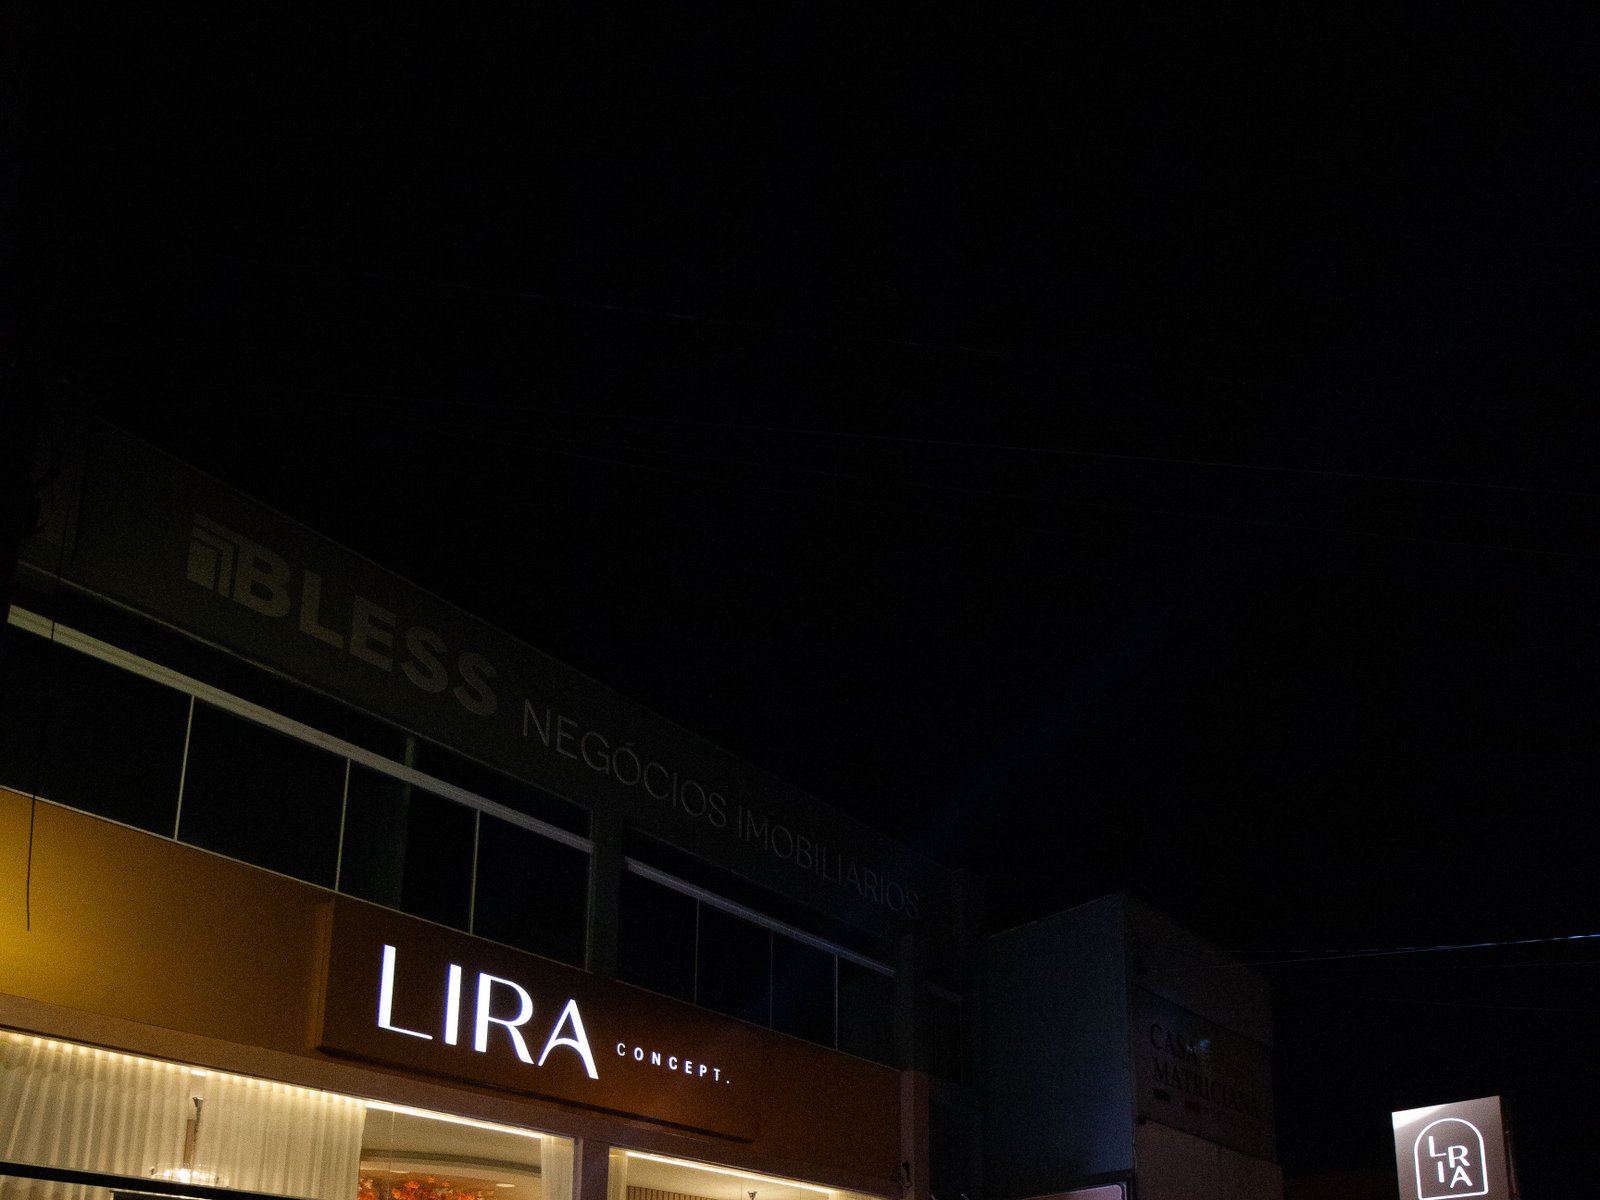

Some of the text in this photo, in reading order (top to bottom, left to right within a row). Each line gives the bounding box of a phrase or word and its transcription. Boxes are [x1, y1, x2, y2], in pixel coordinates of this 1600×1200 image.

[232, 534, 498, 716] BLESS
[522, 699, 727, 828] NEGÓCIOS
[377, 944, 730, 1084] LIRA CONCEPT.
